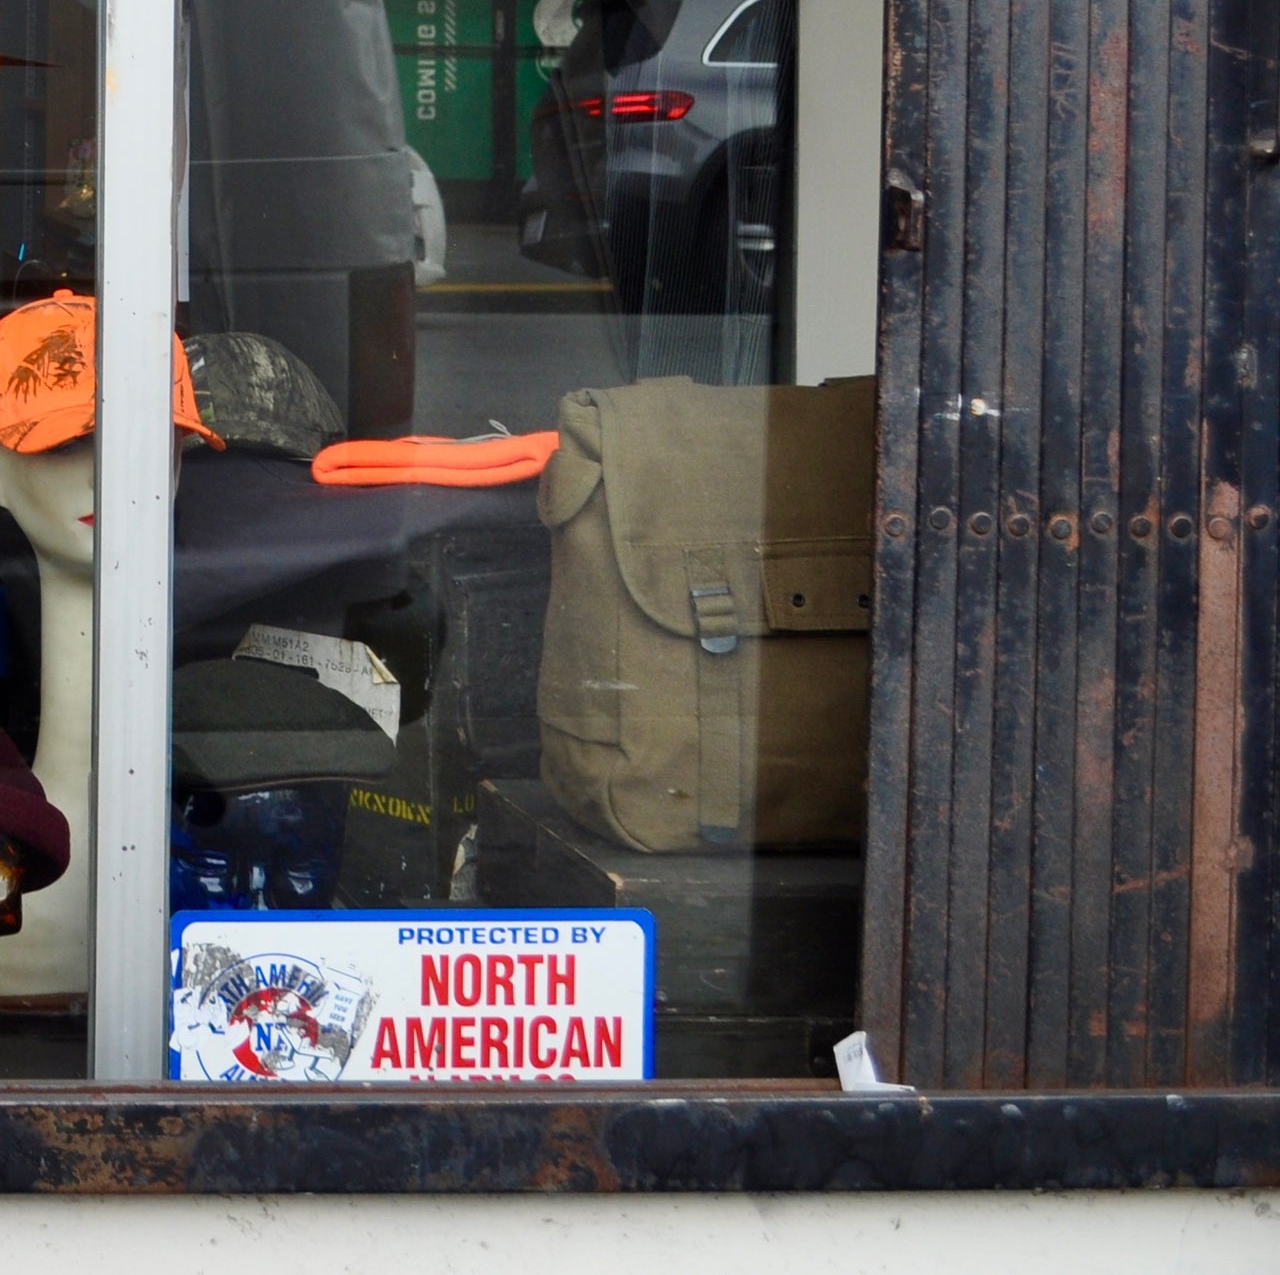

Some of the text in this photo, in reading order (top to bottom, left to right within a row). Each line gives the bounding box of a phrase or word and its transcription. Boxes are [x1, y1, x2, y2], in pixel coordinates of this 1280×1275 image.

[397, 926, 607, 945] PROTECTED BY
[420, 953, 576, 1007] NORTH
[370, 1015, 623, 1070] AMERICAN
